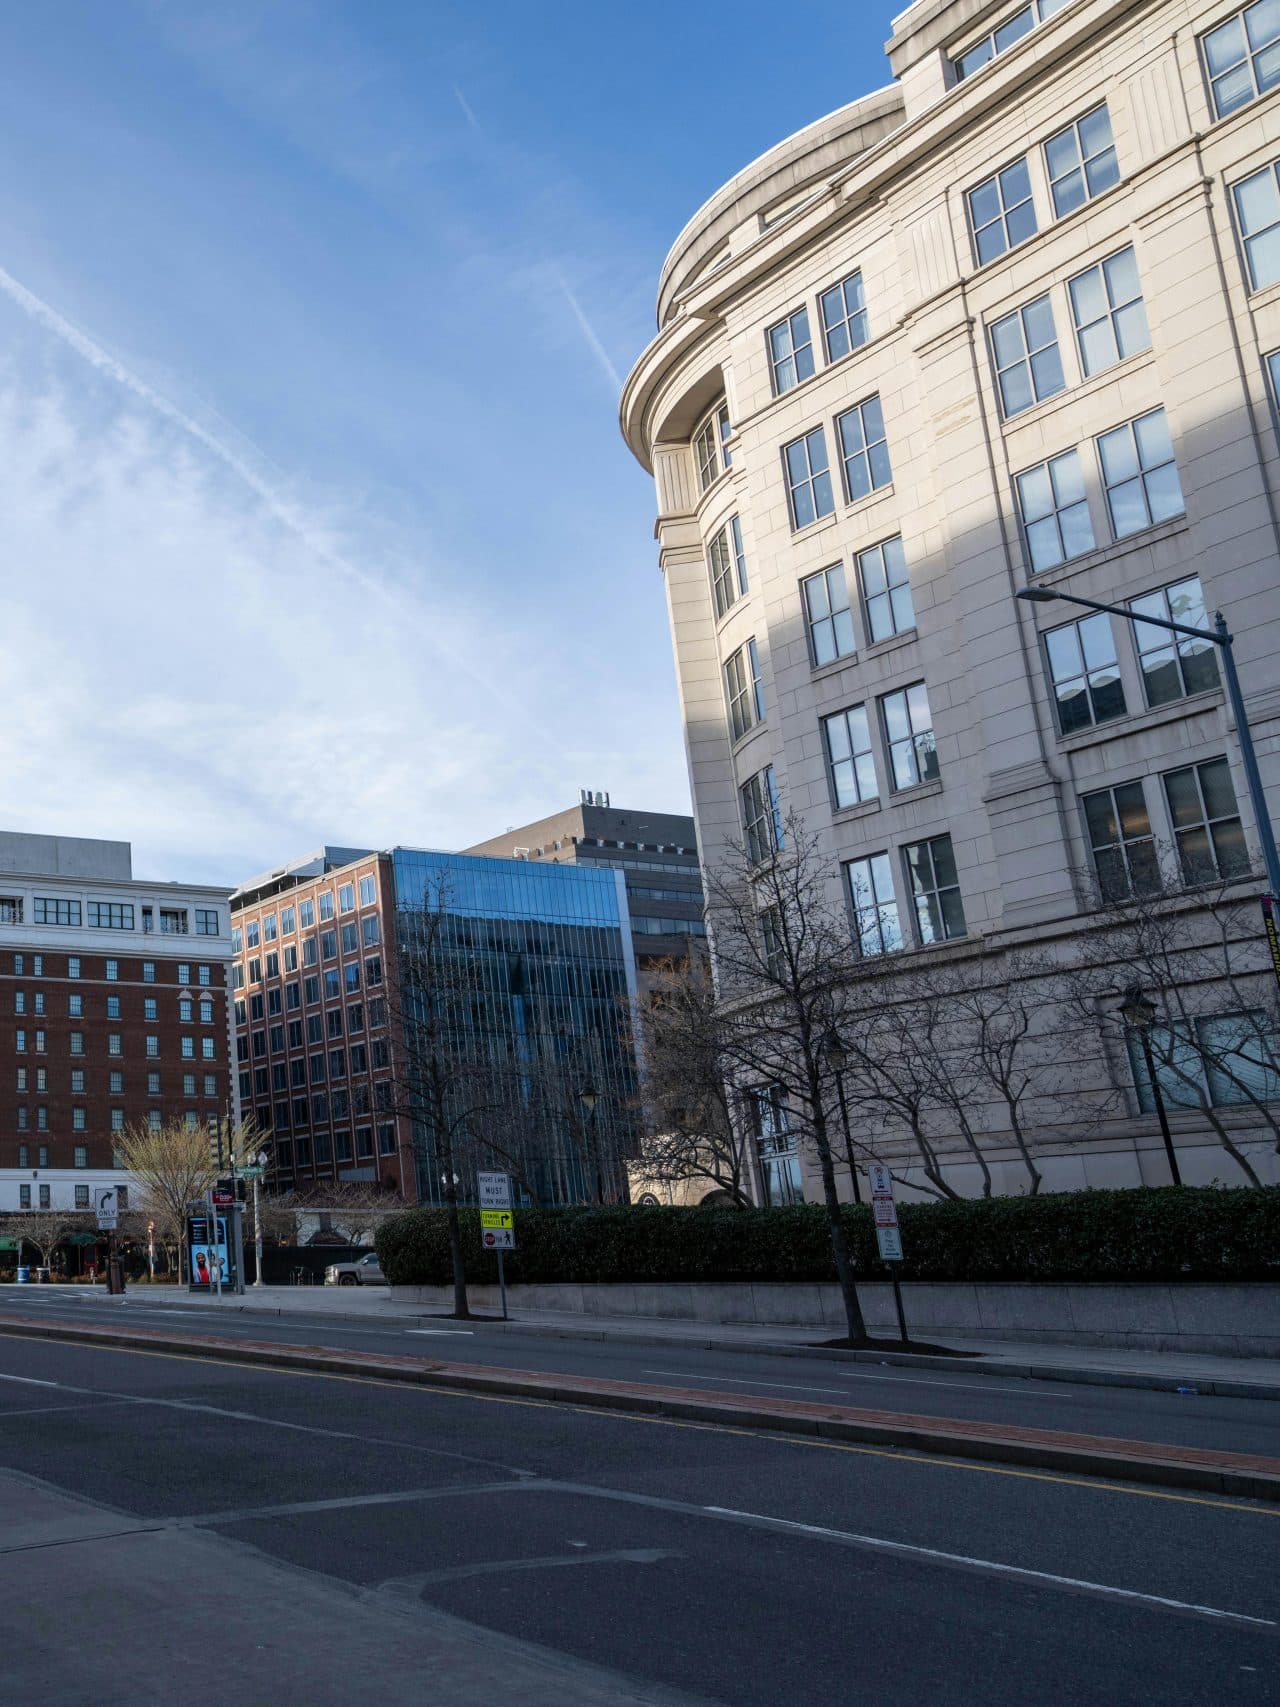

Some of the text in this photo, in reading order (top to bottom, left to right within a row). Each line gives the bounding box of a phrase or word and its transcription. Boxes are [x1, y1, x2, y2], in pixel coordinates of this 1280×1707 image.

[485, 1186, 502, 1195] MUST
[481, 1197, 510, 1206] TURN RIGHT
[98, 1208, 116, 1217] ONLY
